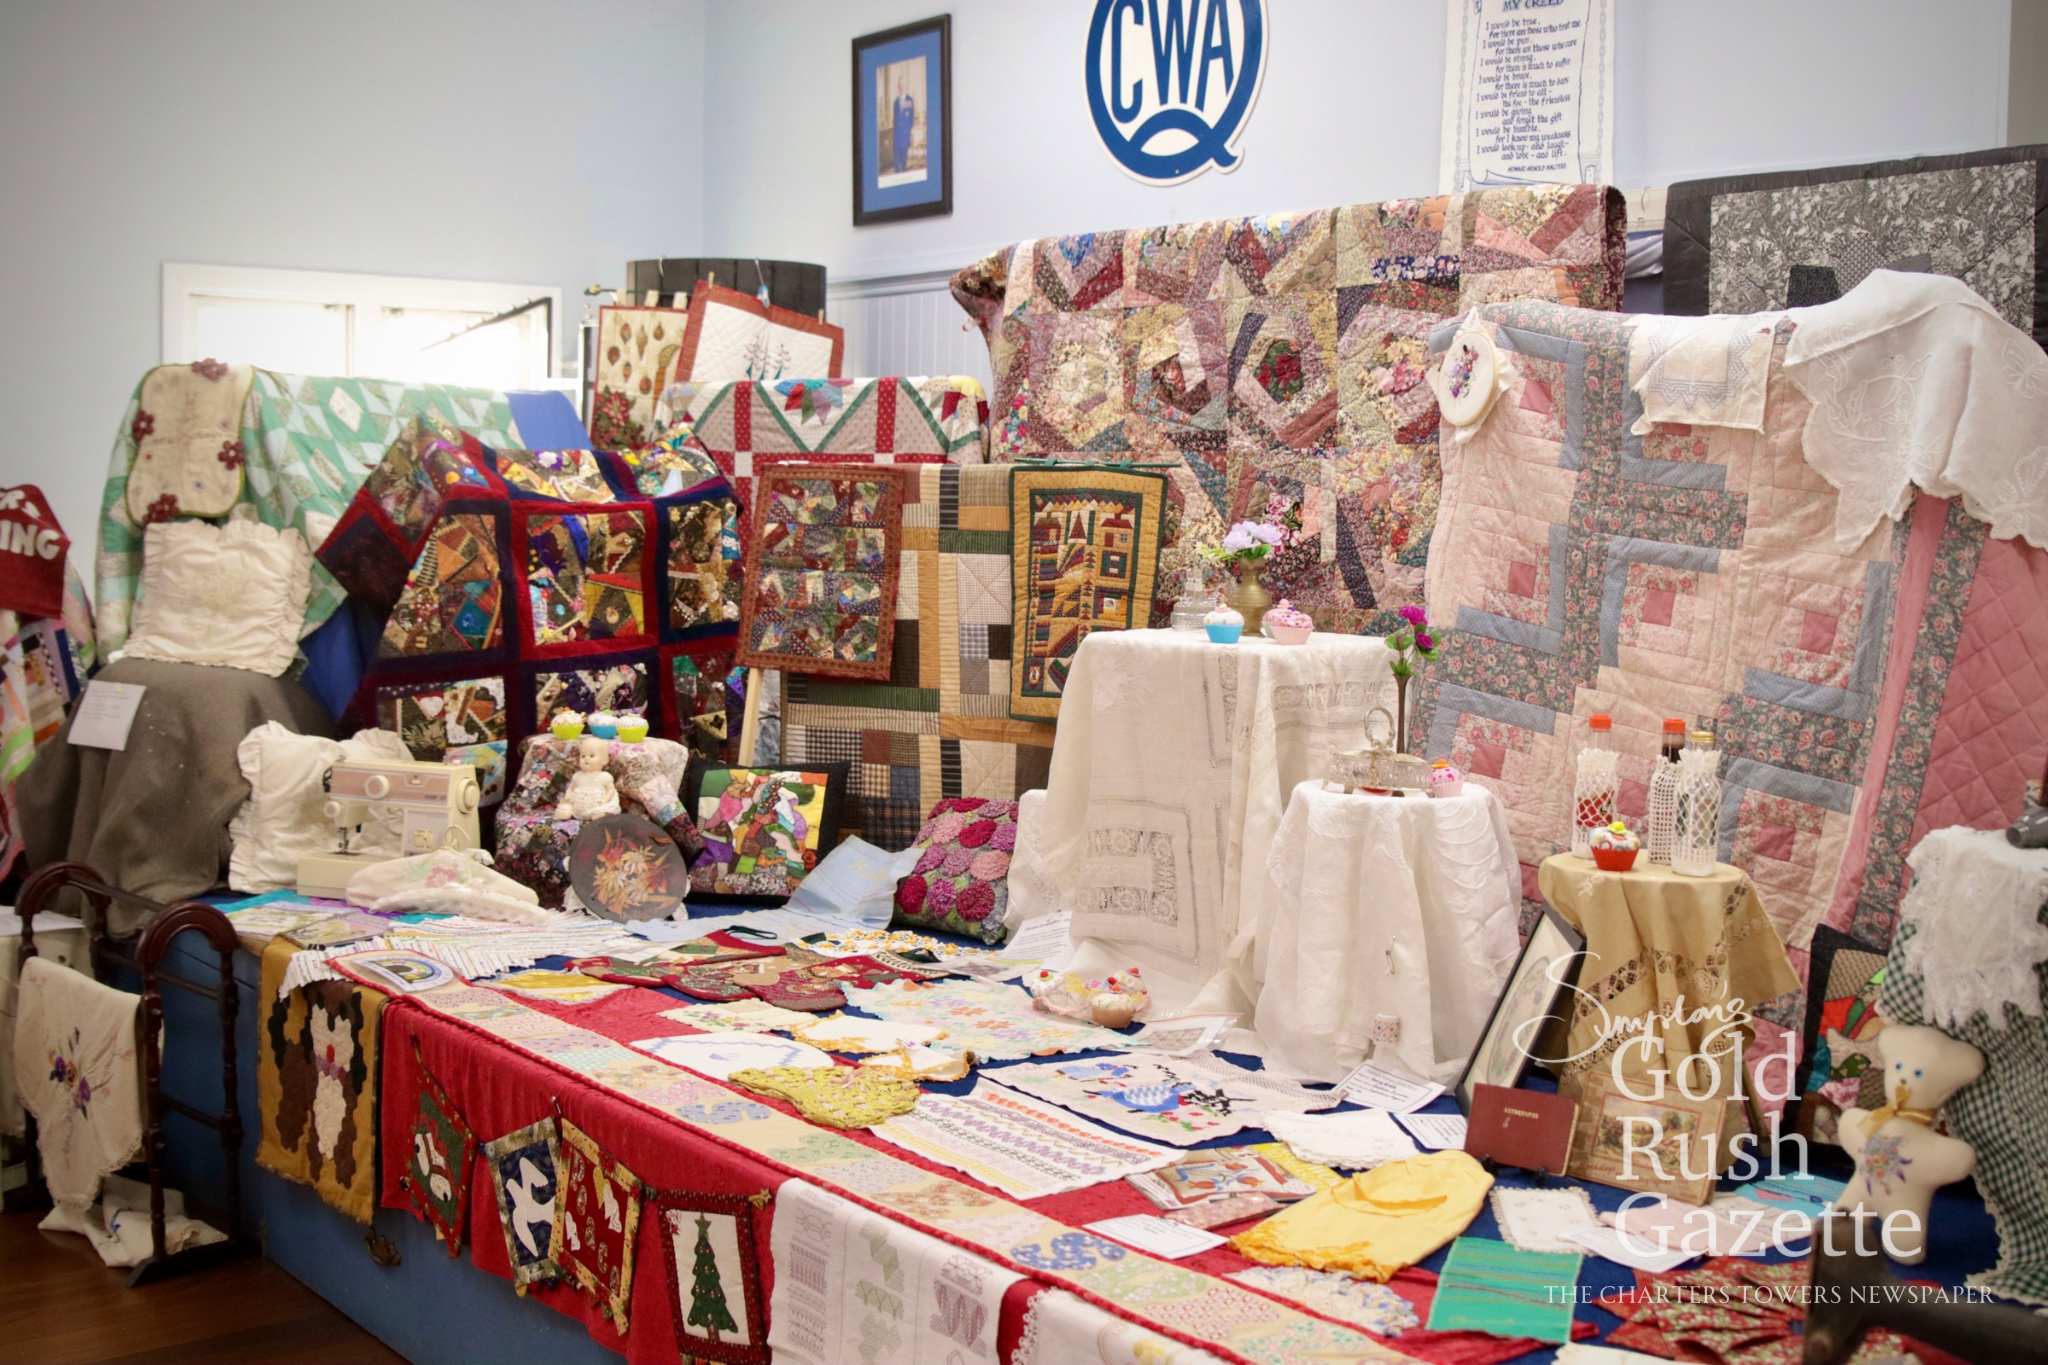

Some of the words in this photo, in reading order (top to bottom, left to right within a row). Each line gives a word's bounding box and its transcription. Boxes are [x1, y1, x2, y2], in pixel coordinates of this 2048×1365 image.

[1502, 0, 1520, 12] MY
[1525, 0, 1564, 9] CREED
[1491, 19, 1510, 30] would
[1512, 18, 1520, 27] be
[1501, 29, 1515, 37] there
[1527, 26, 1542, 34] those
[1543, 25, 1558, 33] who
[1559, 22, 1570, 31] trust
[1571, 20, 1581, 28] me
[1487, 38, 1506, 48] would
[1507, 37, 1515, 46] be
[1495, 48, 1505, 57] for
[1506, 46, 1521, 55] there
[1532, 43, 1550, 52] those
[1551, 41, 1565, 50] who
[1111, 0, 1234, 124] CWA
[1485, 56, 1503, 65] would
[1495, 66, 1505, 74] for
[1506, 63, 1521, 72] there
[1522, 63, 1527, 71] is
[1528, 61, 1545, 70] much
[1546, 60, 1553, 69] to
[1555, 57, 1571, 68] suffer
[1482, 74, 1501, 83] would
[1503, 73, 1510, 81] be
[1494, 82, 1503, 91] for
[1505, 80, 1520, 89] there
[1522, 80, 1527, 88] is
[1529, 79, 1547, 87] much
[1549, 77, 1556, 86] to
[1557, 76, 1569, 85] dare
[1481, 92, 1499, 101] would
[1501, 91, 1507, 99] be
[1509, 90, 1527, 99] friend
[1503, 100, 1512, 108] the
[1512, 99, 1522, 108] foe
[1528, 97, 1539, 106] the
[1541, 94, 1571, 108] friendless
[1481, 109, 1500, 119] would
[1502, 109, 1509, 117] be
[1511, 108, 1532, 118] giving
[1502, 115, 1514, 125] and
[1516, 114, 1535, 125] forget
[1537, 114, 1548, 122] the
[1550, 111, 1563, 125] gift
[1481, 126, 1500, 136] would
[1503, 126, 1511, 134] be
[1495, 134, 1506, 144] for
[1511, 133, 1528, 142] know
[1529, 133, 1540, 143] my
[1541, 130, 1571, 141] weakness
[1481, 144, 1499, 153] would
[1501, 142, 1515, 151] look
[1531, 141, 1544, 150] and
[1501, 152, 1514, 160] and
[1516, 151, 1529, 160] love
[1536, 150, 1549, 159] and
[1503, 1106, 1539, 1119] AUTOGRAPHS
